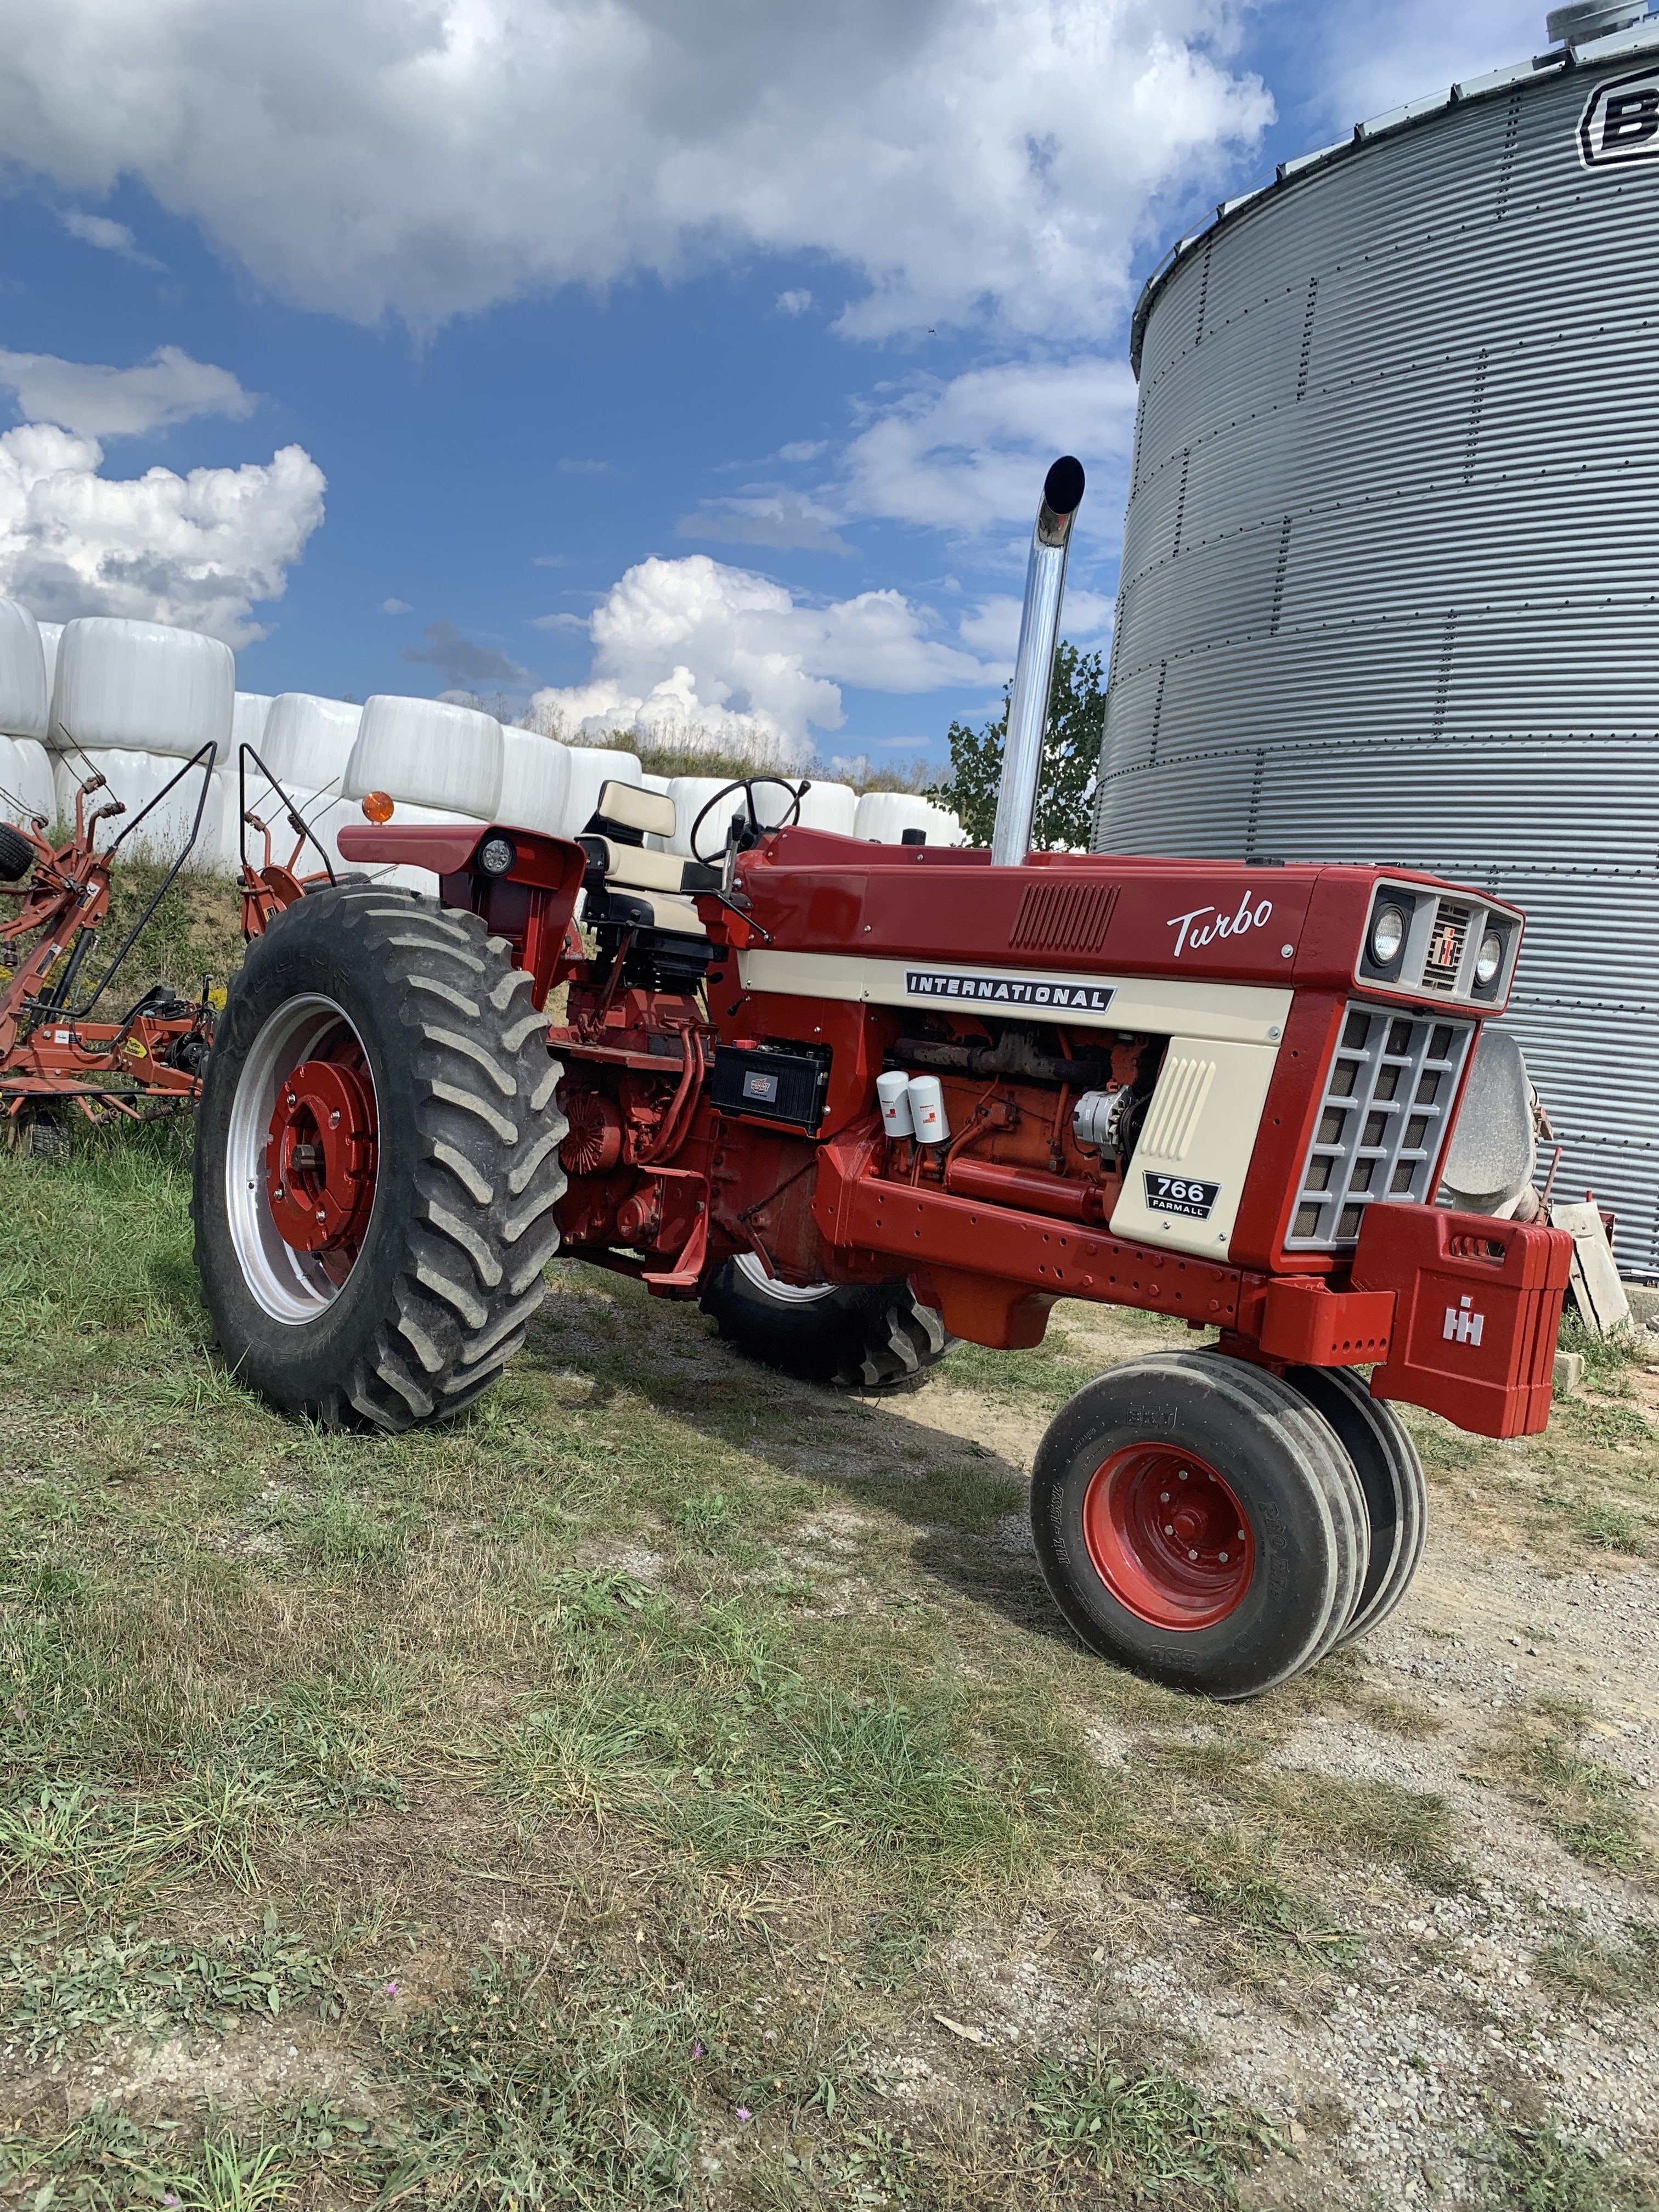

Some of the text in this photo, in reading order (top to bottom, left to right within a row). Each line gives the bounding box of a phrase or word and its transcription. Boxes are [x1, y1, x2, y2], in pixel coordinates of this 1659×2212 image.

[1601, 88, 1659, 150] B
[1166, 890, 1272, 957] Turbo
[910, 976, 1105, 1008] INTERNATIONAL
[128, 1040, 140, 1049] Turbo
[1158, 1177, 1204, 1202] 766
[1153, 1200, 1203, 1216] FARMALL
[1127, 1406, 1177, 1427] BKT
